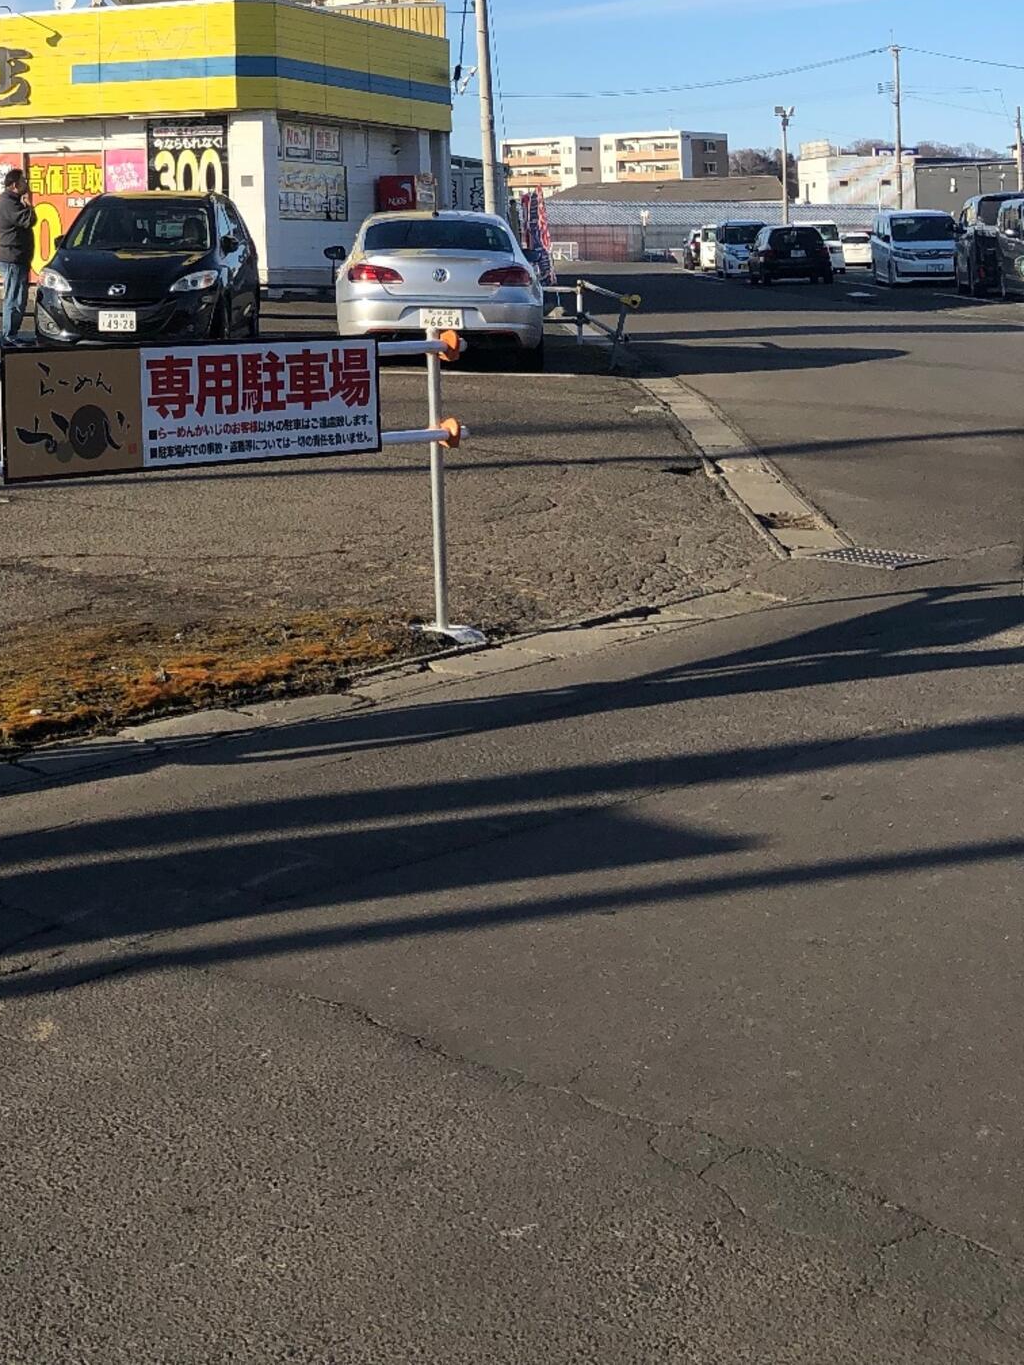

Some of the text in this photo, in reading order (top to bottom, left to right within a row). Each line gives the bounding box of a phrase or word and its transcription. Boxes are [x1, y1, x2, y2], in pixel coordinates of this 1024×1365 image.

[29, 163, 103, 195] 高価買取
[37, 362, 112, 396] らーめん
[146, 348, 371, 420] 専用駐車場
